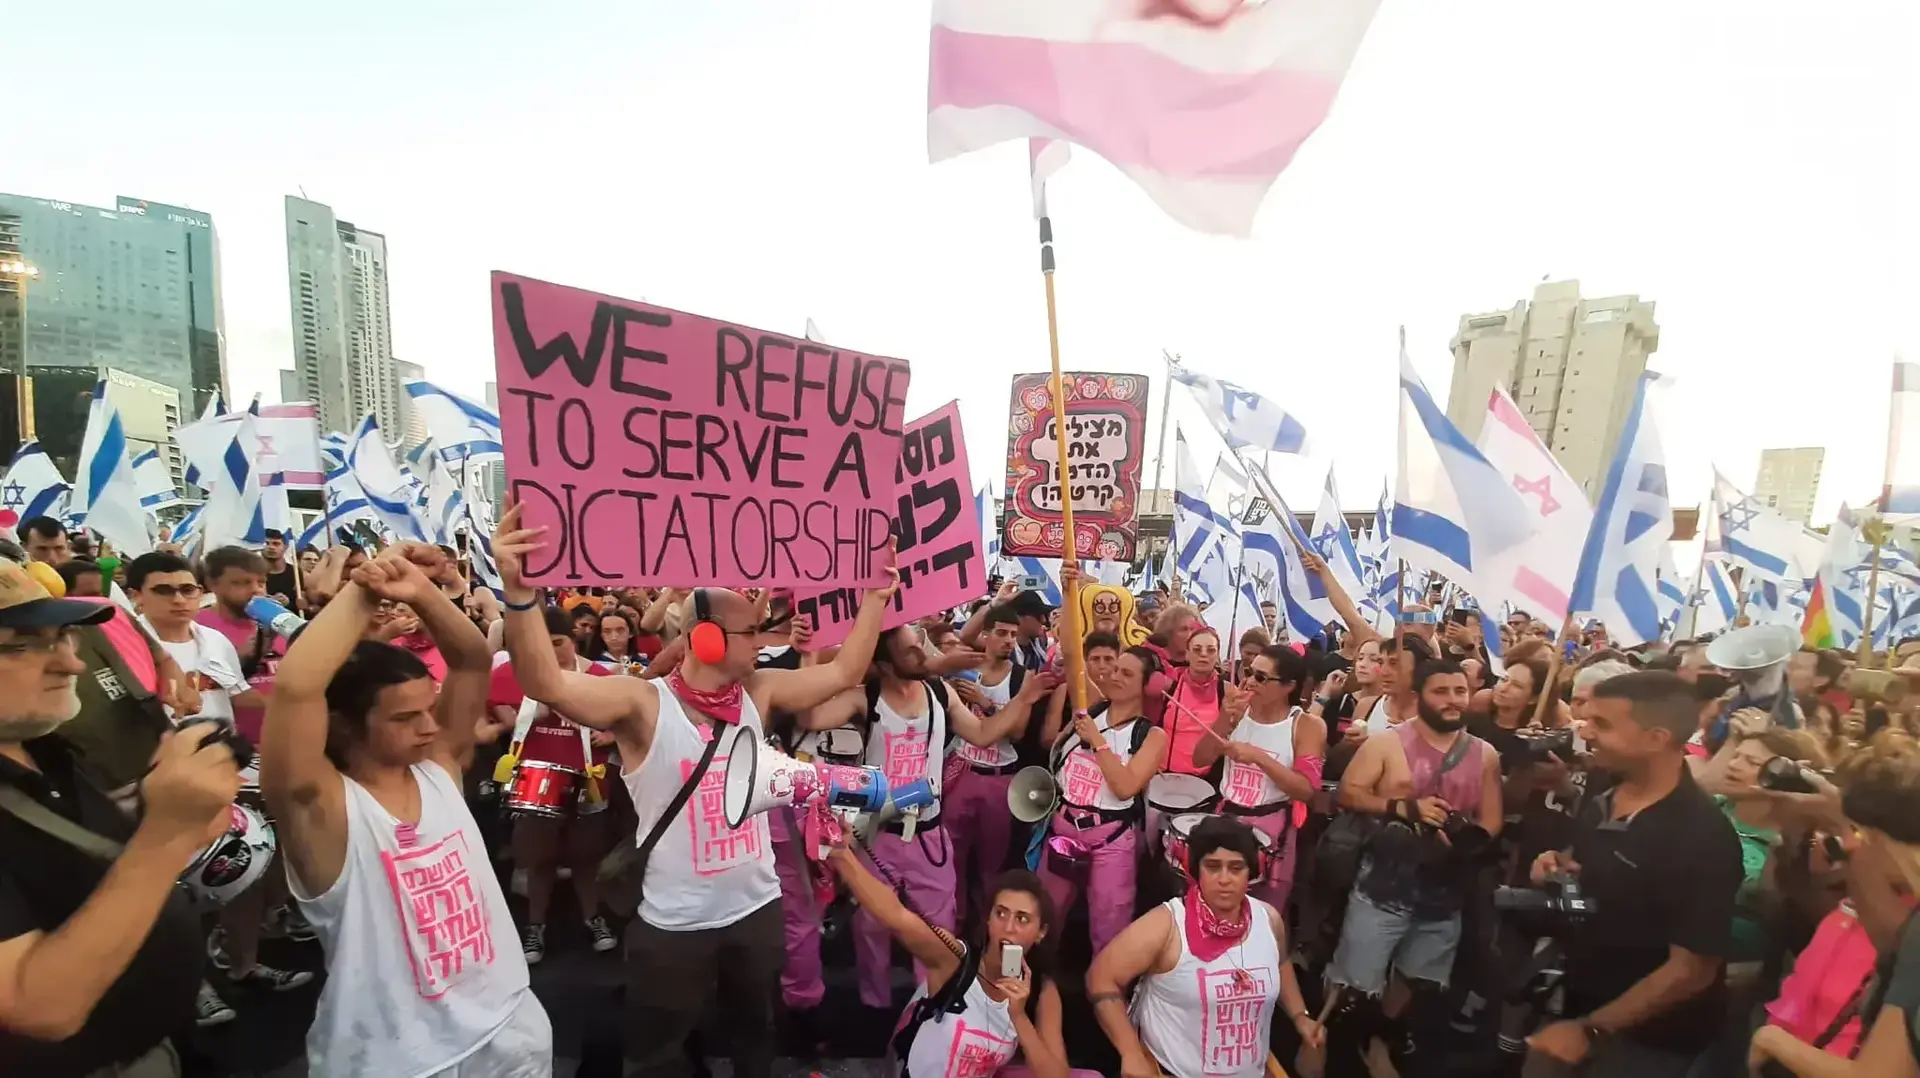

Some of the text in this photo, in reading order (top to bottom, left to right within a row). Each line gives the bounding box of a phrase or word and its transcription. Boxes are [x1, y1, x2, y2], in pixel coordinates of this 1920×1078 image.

[501, 282, 910, 436] WE REFUSE
[506, 387, 871, 499] TO SERVE A
[1067, 442, 1100, 459] את
[1041, 484, 1114, 507] קרטה!
[512, 479, 892, 581] DICTATORSHIP
[1217, 1000, 1264, 1024] דורש
